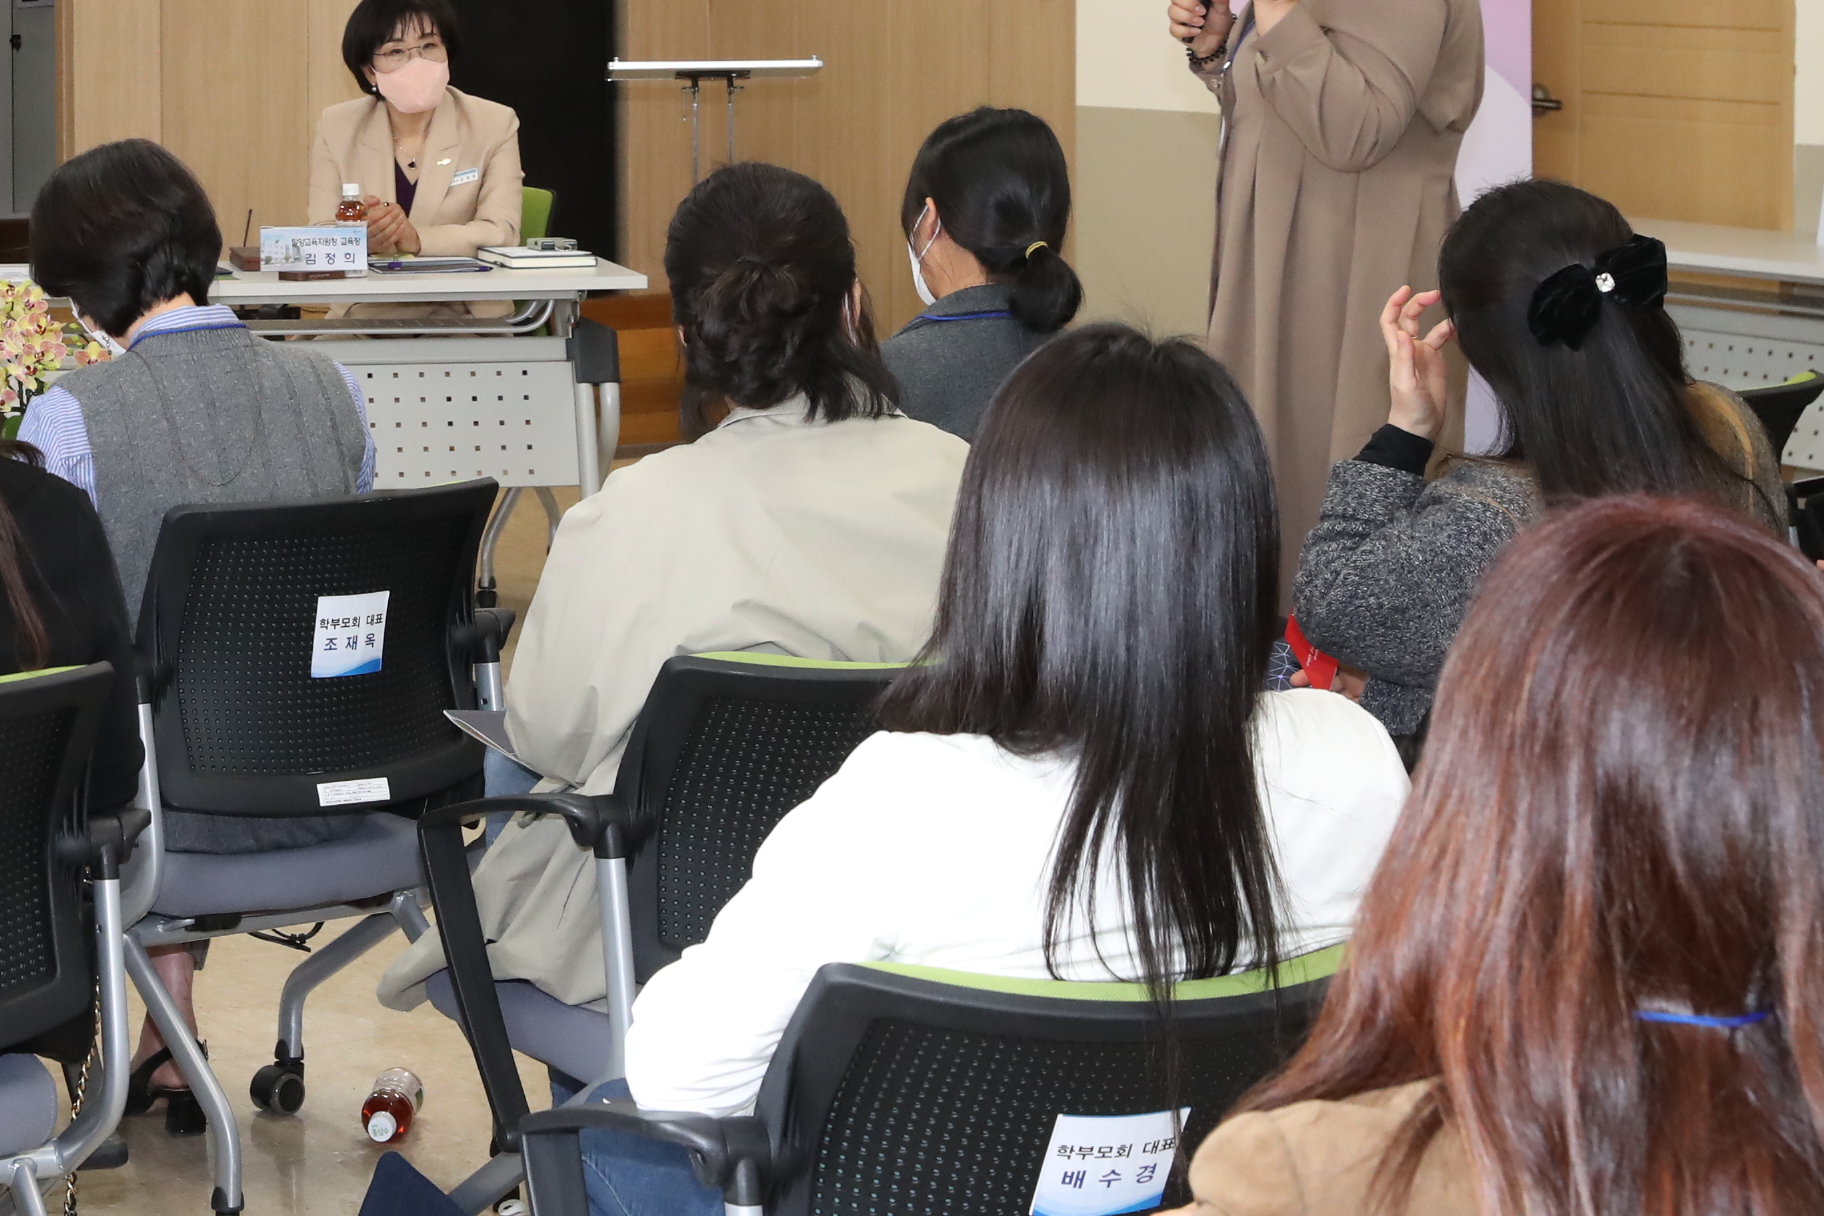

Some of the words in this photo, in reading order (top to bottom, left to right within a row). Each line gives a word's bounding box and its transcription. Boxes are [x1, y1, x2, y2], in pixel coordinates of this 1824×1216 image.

[340, 236, 361, 246] 교육장
[319, 615, 361, 630] 학부모회
[366, 613, 383, 626] 대표
[1056, 1142, 1133, 1161] 학부모회
[1142, 1137, 1176, 1155] 대표
